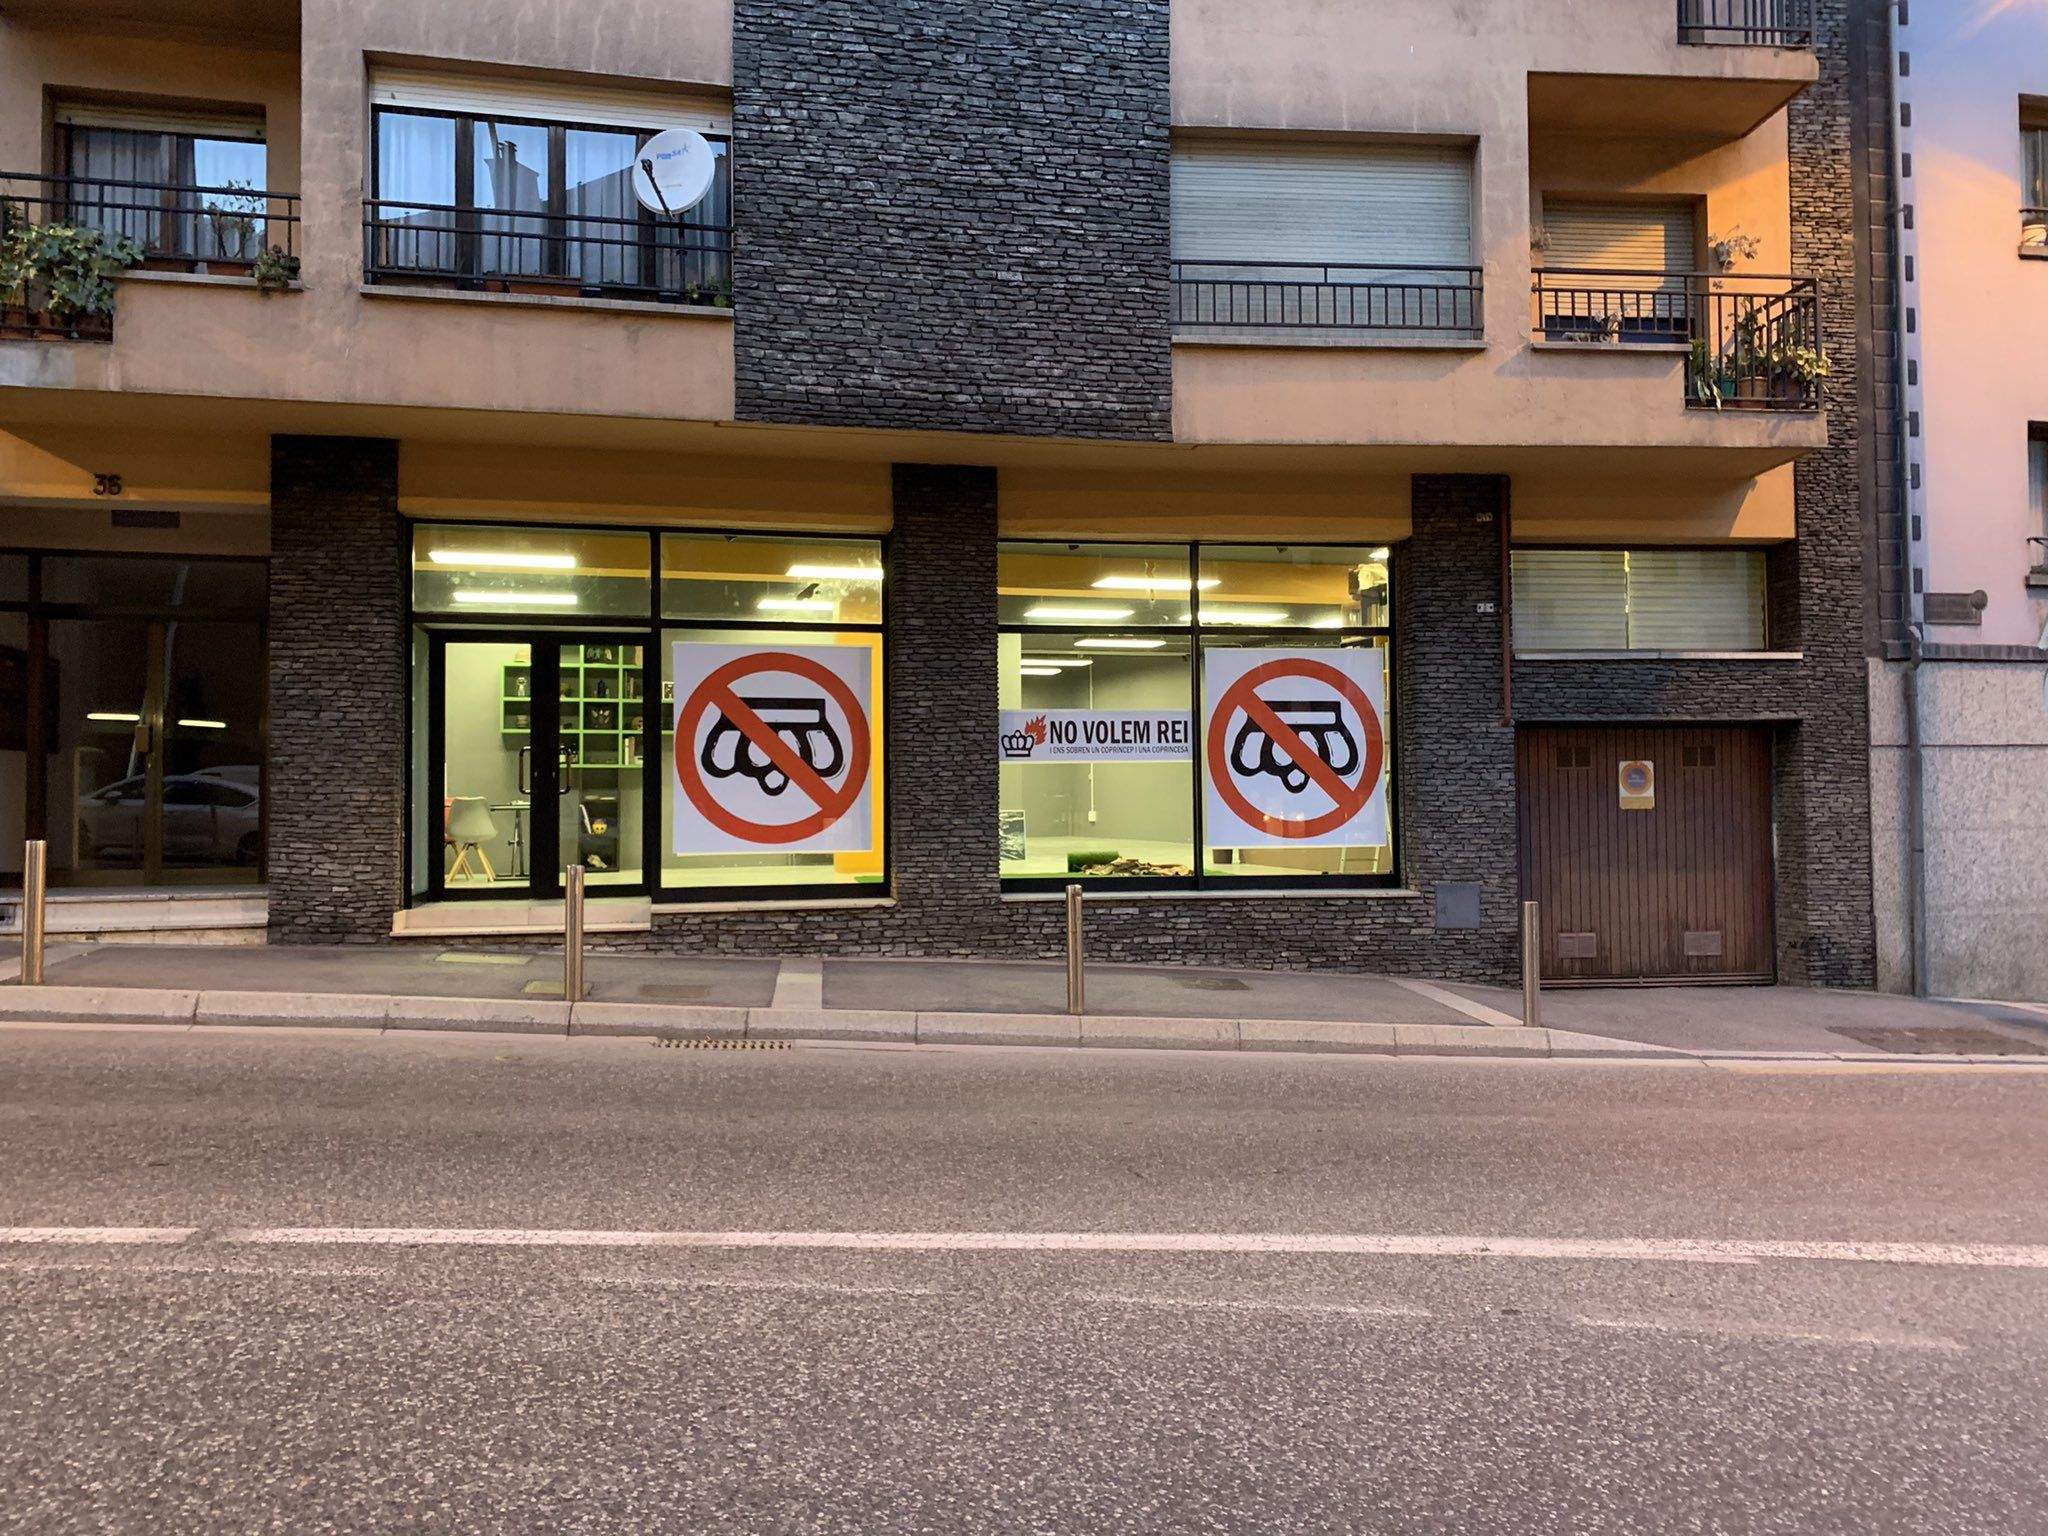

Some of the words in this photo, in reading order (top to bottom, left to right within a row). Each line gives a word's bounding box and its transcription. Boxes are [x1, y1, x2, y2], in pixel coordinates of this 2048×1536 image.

[1050, 720, 1077, 744] NO
[1082, 720, 1150, 744] VOLEM
[1157, 720, 1188, 744] REI
[1053, 746, 1065, 754] ENS
[1066, 746, 1090, 754] SOBREN
[1091, 746, 1100, 754] UN
[1101, 746, 1134, 754] COPRINCEP
[1139, 746, 1151, 754] UNA
[1152, 745, 1188, 754] COPRINCESA
